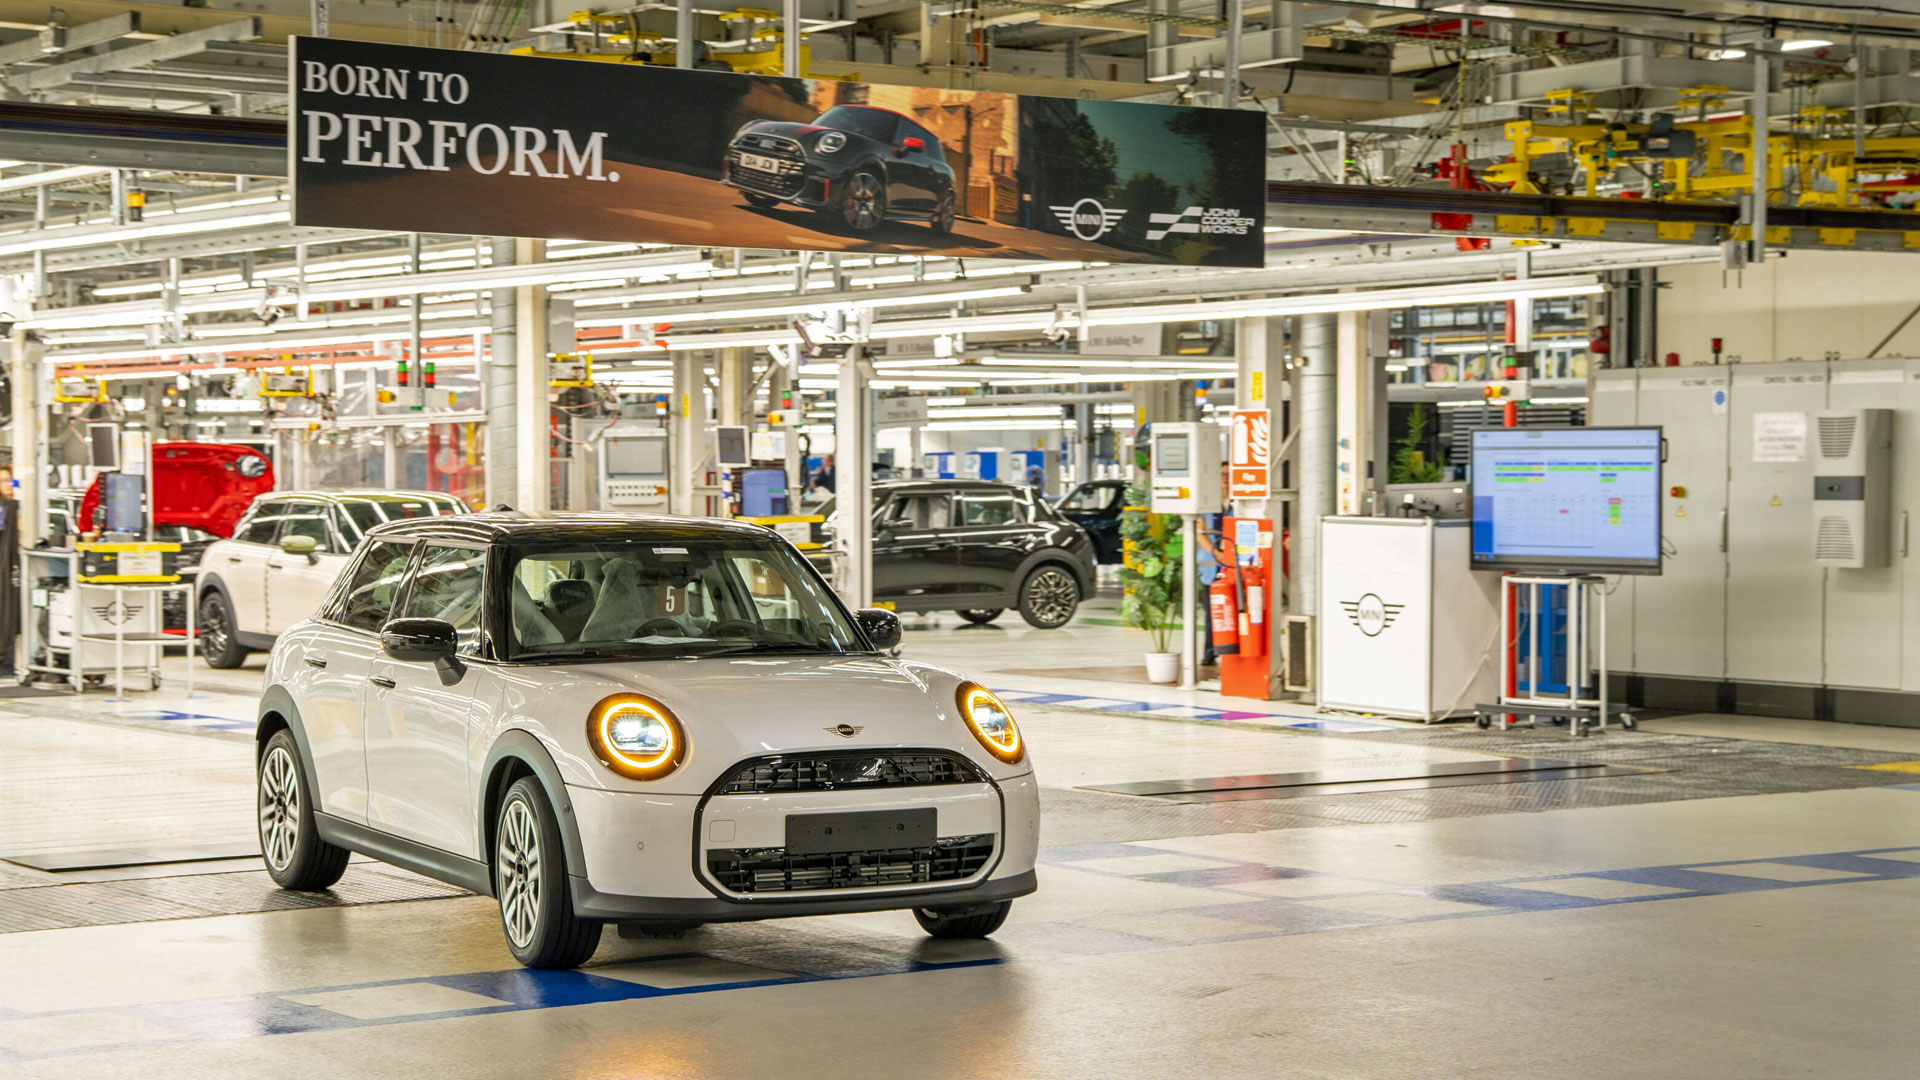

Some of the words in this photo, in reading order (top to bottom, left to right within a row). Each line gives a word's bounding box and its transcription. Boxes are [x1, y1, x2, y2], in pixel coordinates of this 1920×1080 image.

[302, 60, 410, 101] BORN
[418, 71, 470, 105] TO
[302, 110, 621, 184] PERFORM.
[1202, 207, 1241, 218] JOHN
[1075, 213, 1102, 226] MINI
[1201, 217, 1256, 227] COOPER
[1200, 225, 1248, 235] WORKS
[665, 585, 676, 613] 5
